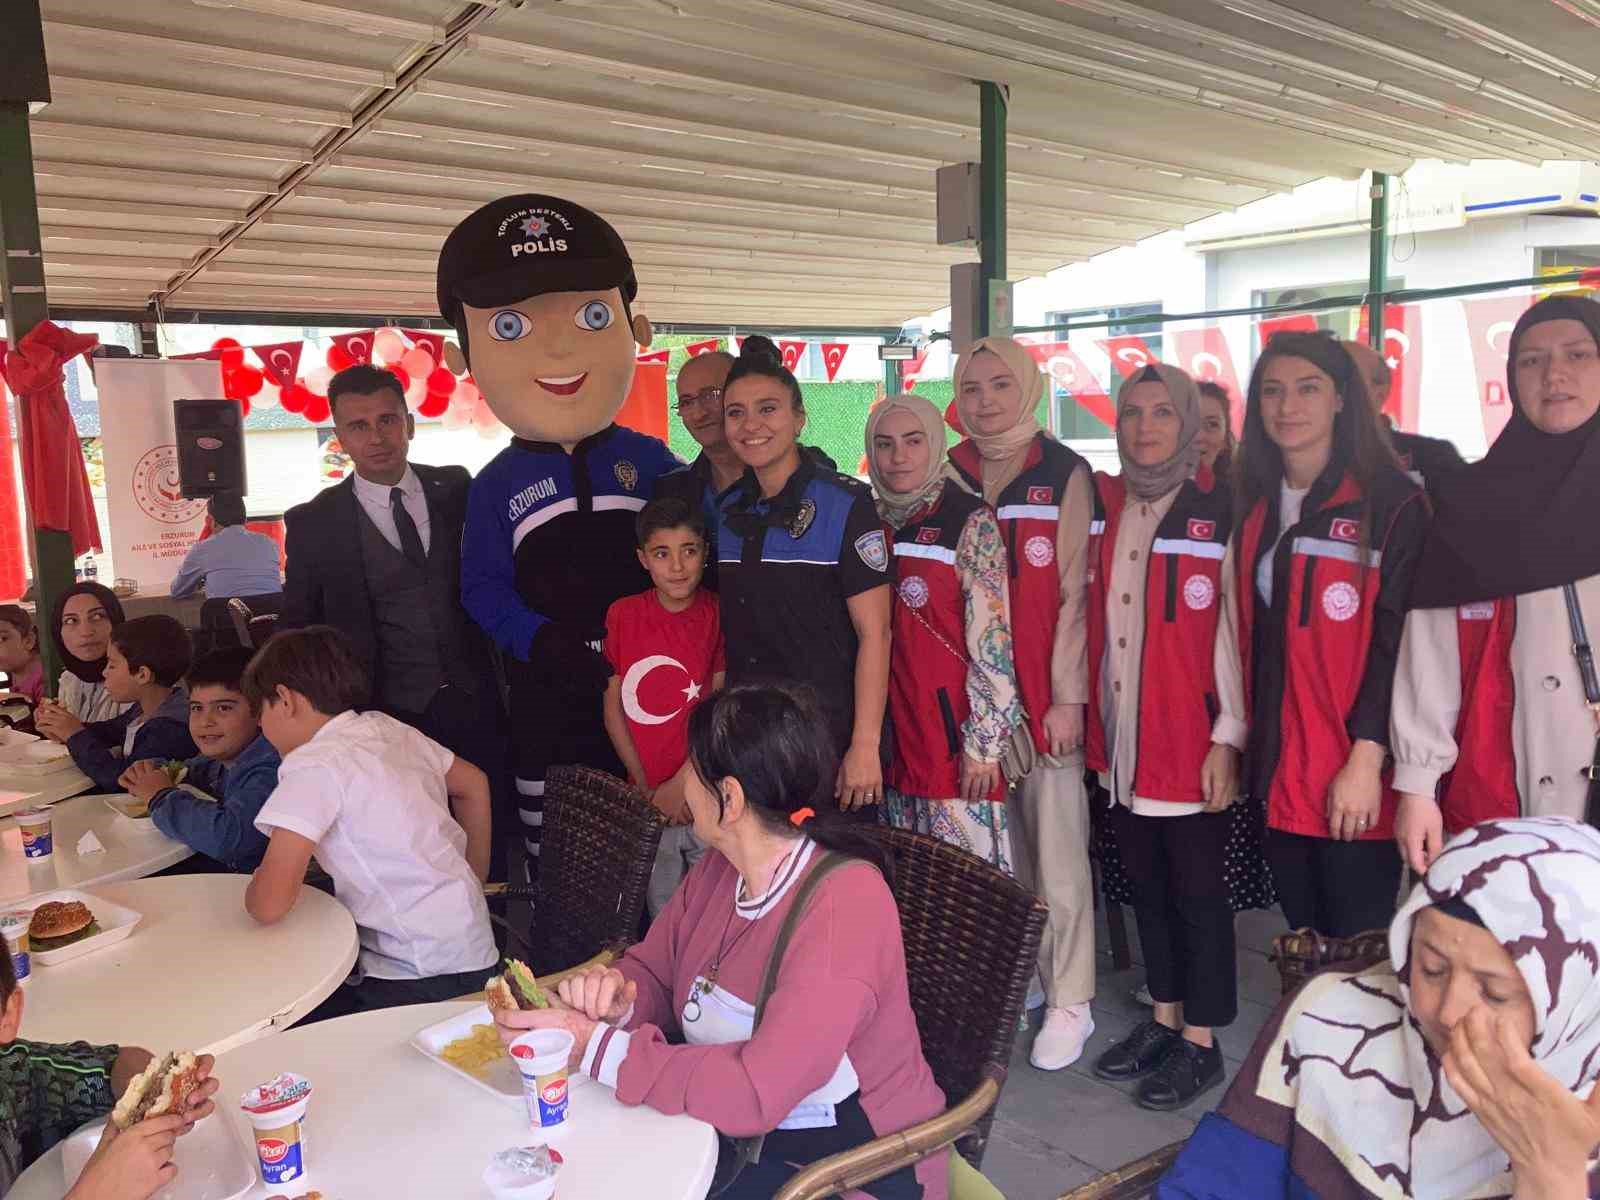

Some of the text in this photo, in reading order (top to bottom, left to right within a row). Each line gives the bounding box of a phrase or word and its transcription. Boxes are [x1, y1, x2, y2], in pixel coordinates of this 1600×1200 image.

[498, 210, 527, 237] TOPLUM
[511, 237, 568, 257] POLİS
[509, 477, 558, 521] ERZURUM
